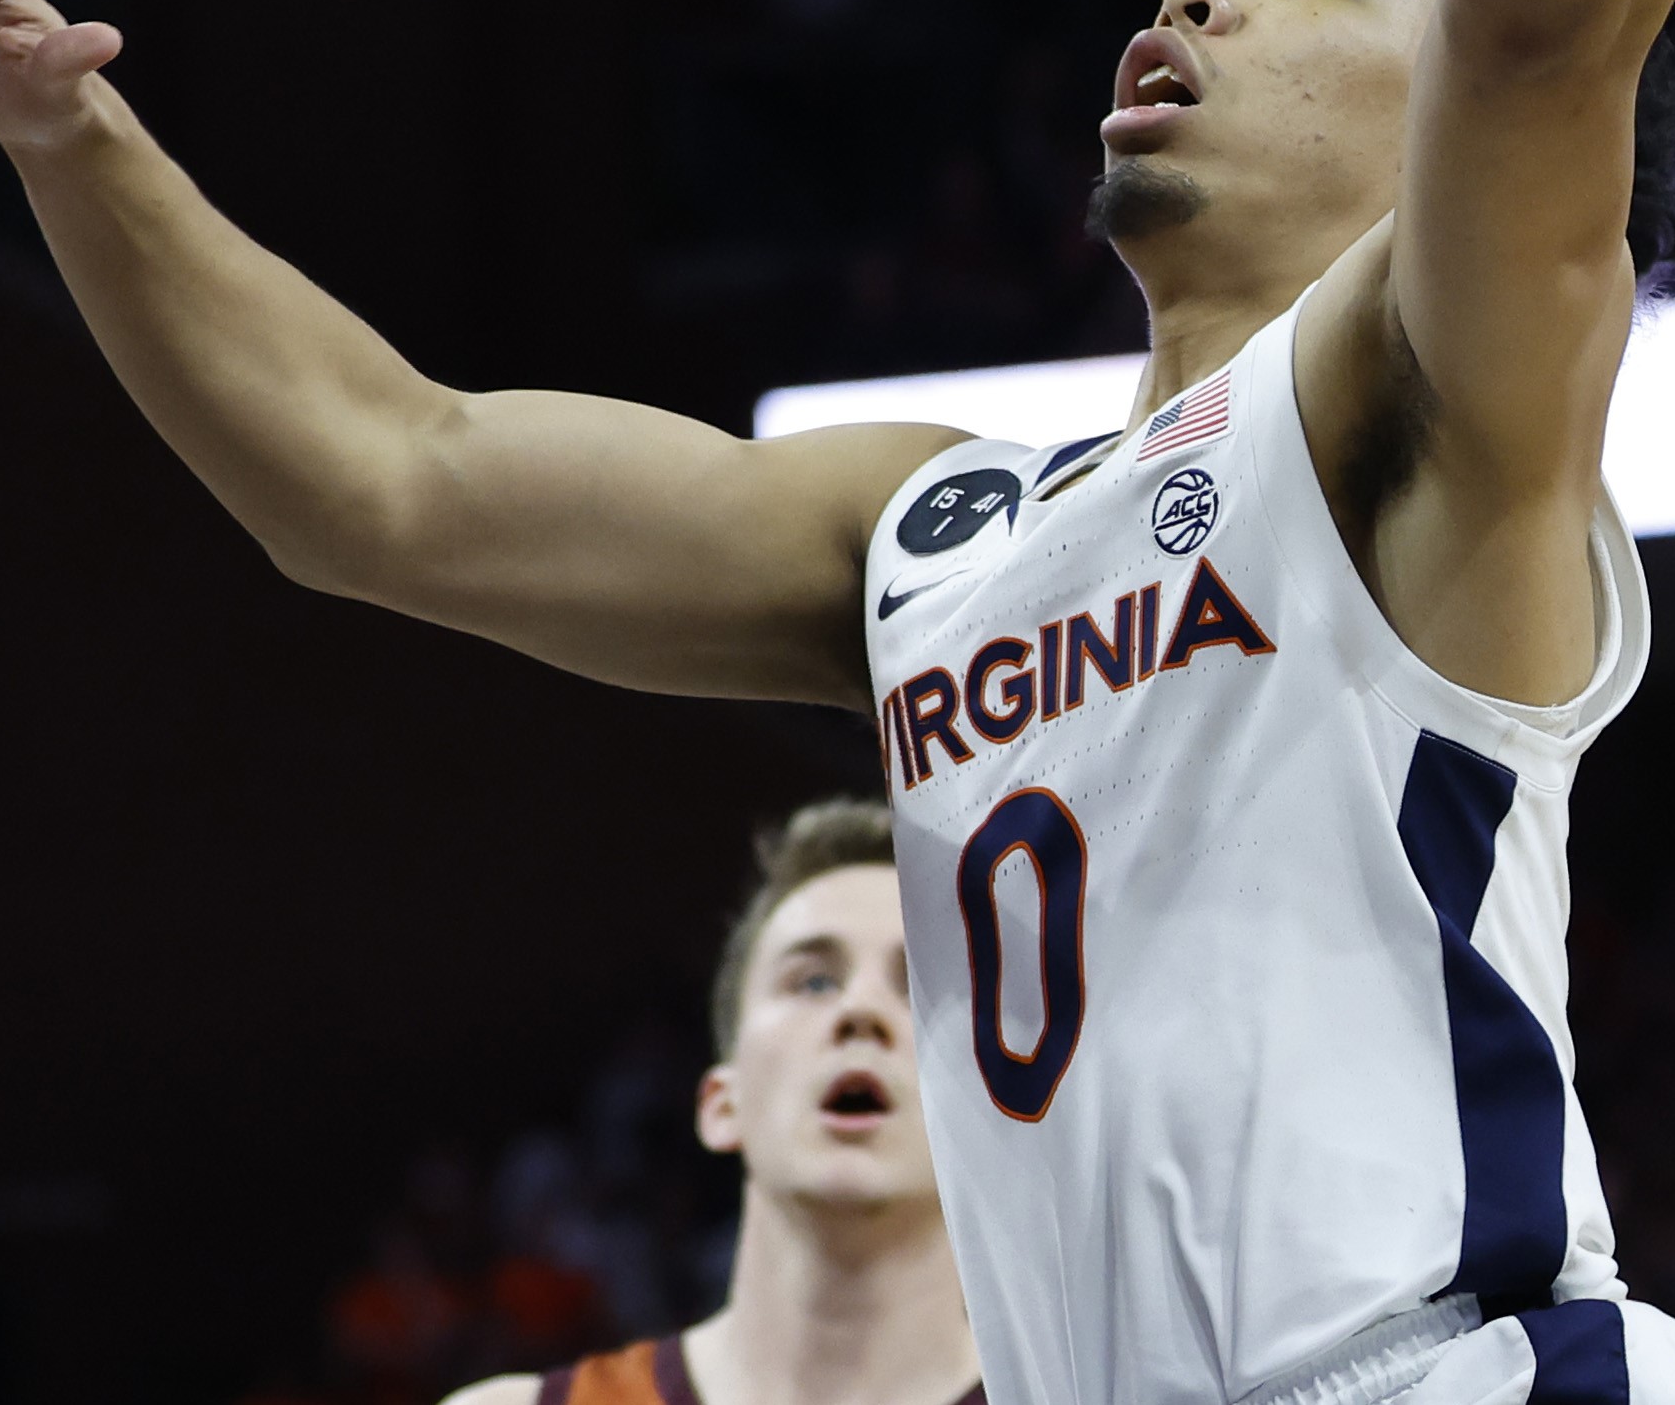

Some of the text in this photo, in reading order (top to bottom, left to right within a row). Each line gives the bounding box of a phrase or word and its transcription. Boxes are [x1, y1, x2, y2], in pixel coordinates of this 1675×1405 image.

[929, 486, 1005, 514] 15 41
[1160, 487, 1216, 522] ACC
[931, 515, 955, 537] 1
[956, 786, 1088, 1123] 0
